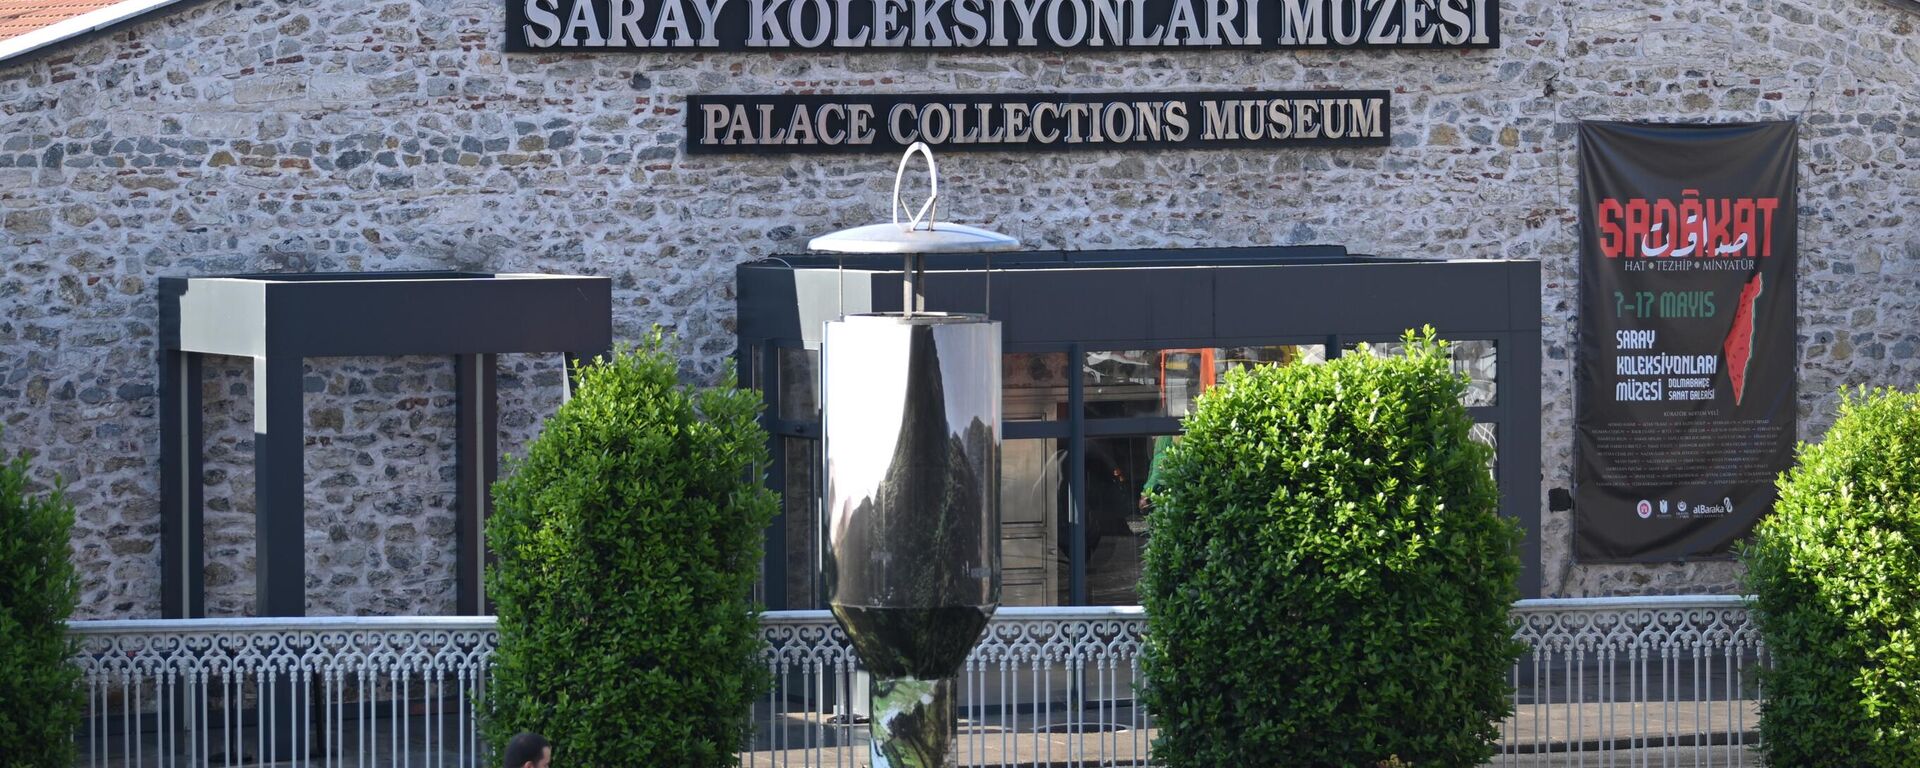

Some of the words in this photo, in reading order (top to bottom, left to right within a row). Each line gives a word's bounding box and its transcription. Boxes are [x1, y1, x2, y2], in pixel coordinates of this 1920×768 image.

[522, 0, 727, 48] SARAY
[700, 102, 876, 146] PALACE
[887, 100, 1190, 145] COLLECTIONS
[1201, 97, 1384, 140] MUSEUM
[1624, 260, 1647, 271] HAT
[1655, 258, 1692, 271] TEZHİP
[1702, 258, 1755, 271] MİNYATÜR
[1660, 291, 1716, 319] MAYIS
[1616, 329, 1655, 349] SARAY
[1616, 351, 1717, 375] KOLEKSİYONLARI
[1616, 378, 1662, 401] MÜZESİ
[1668, 390, 1689, 401] SANAT
[1693, 503, 1724, 514] alBaraka
